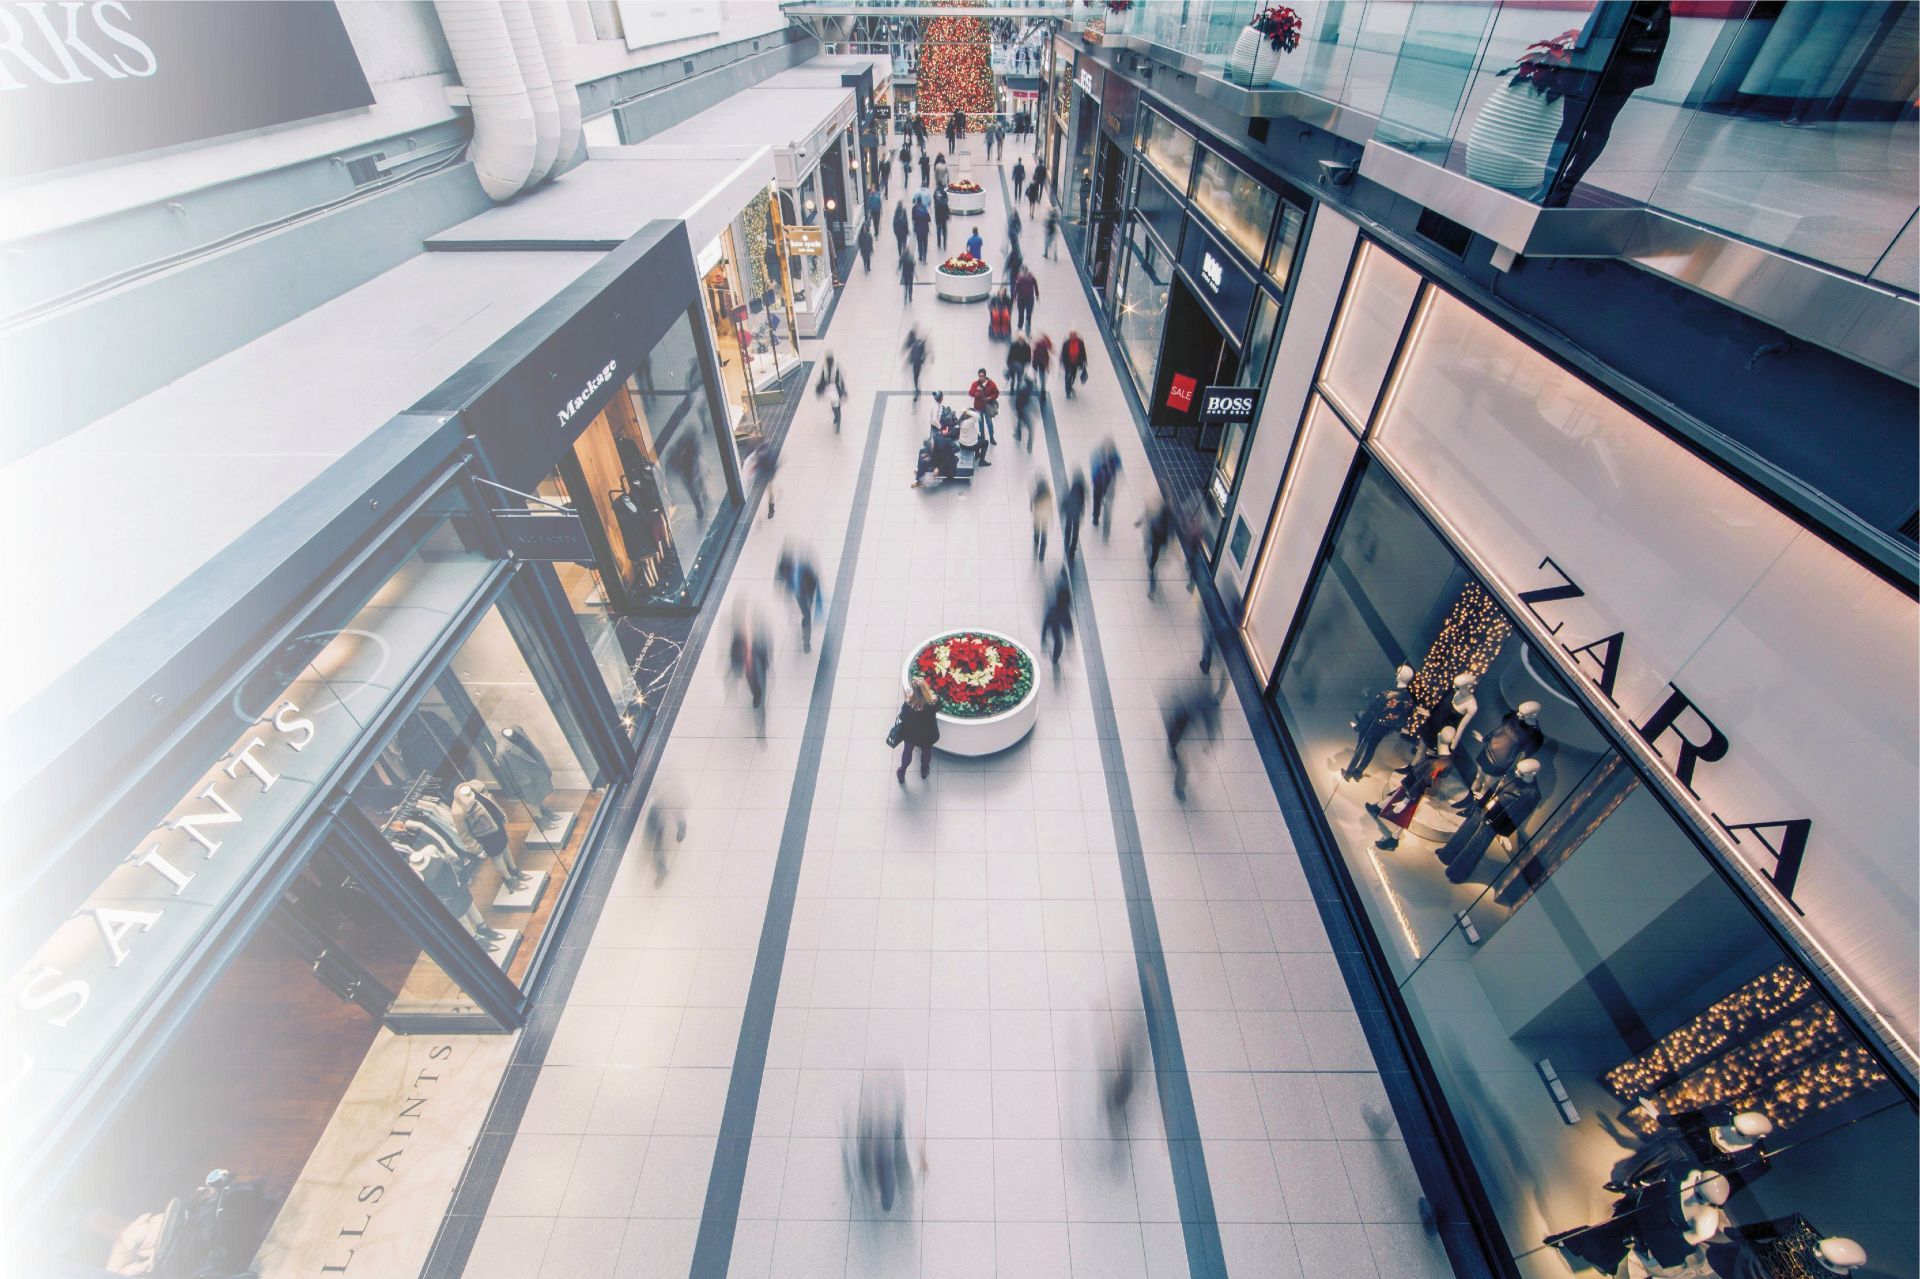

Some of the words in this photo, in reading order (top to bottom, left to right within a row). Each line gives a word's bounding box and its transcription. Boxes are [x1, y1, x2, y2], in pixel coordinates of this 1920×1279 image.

[557, 360, 617, 428] Mackage
[1170, 386, 1192, 401] SALE
[1207, 397, 1252, 411] BOSS
[1518, 556, 1812, 917] ZARA
